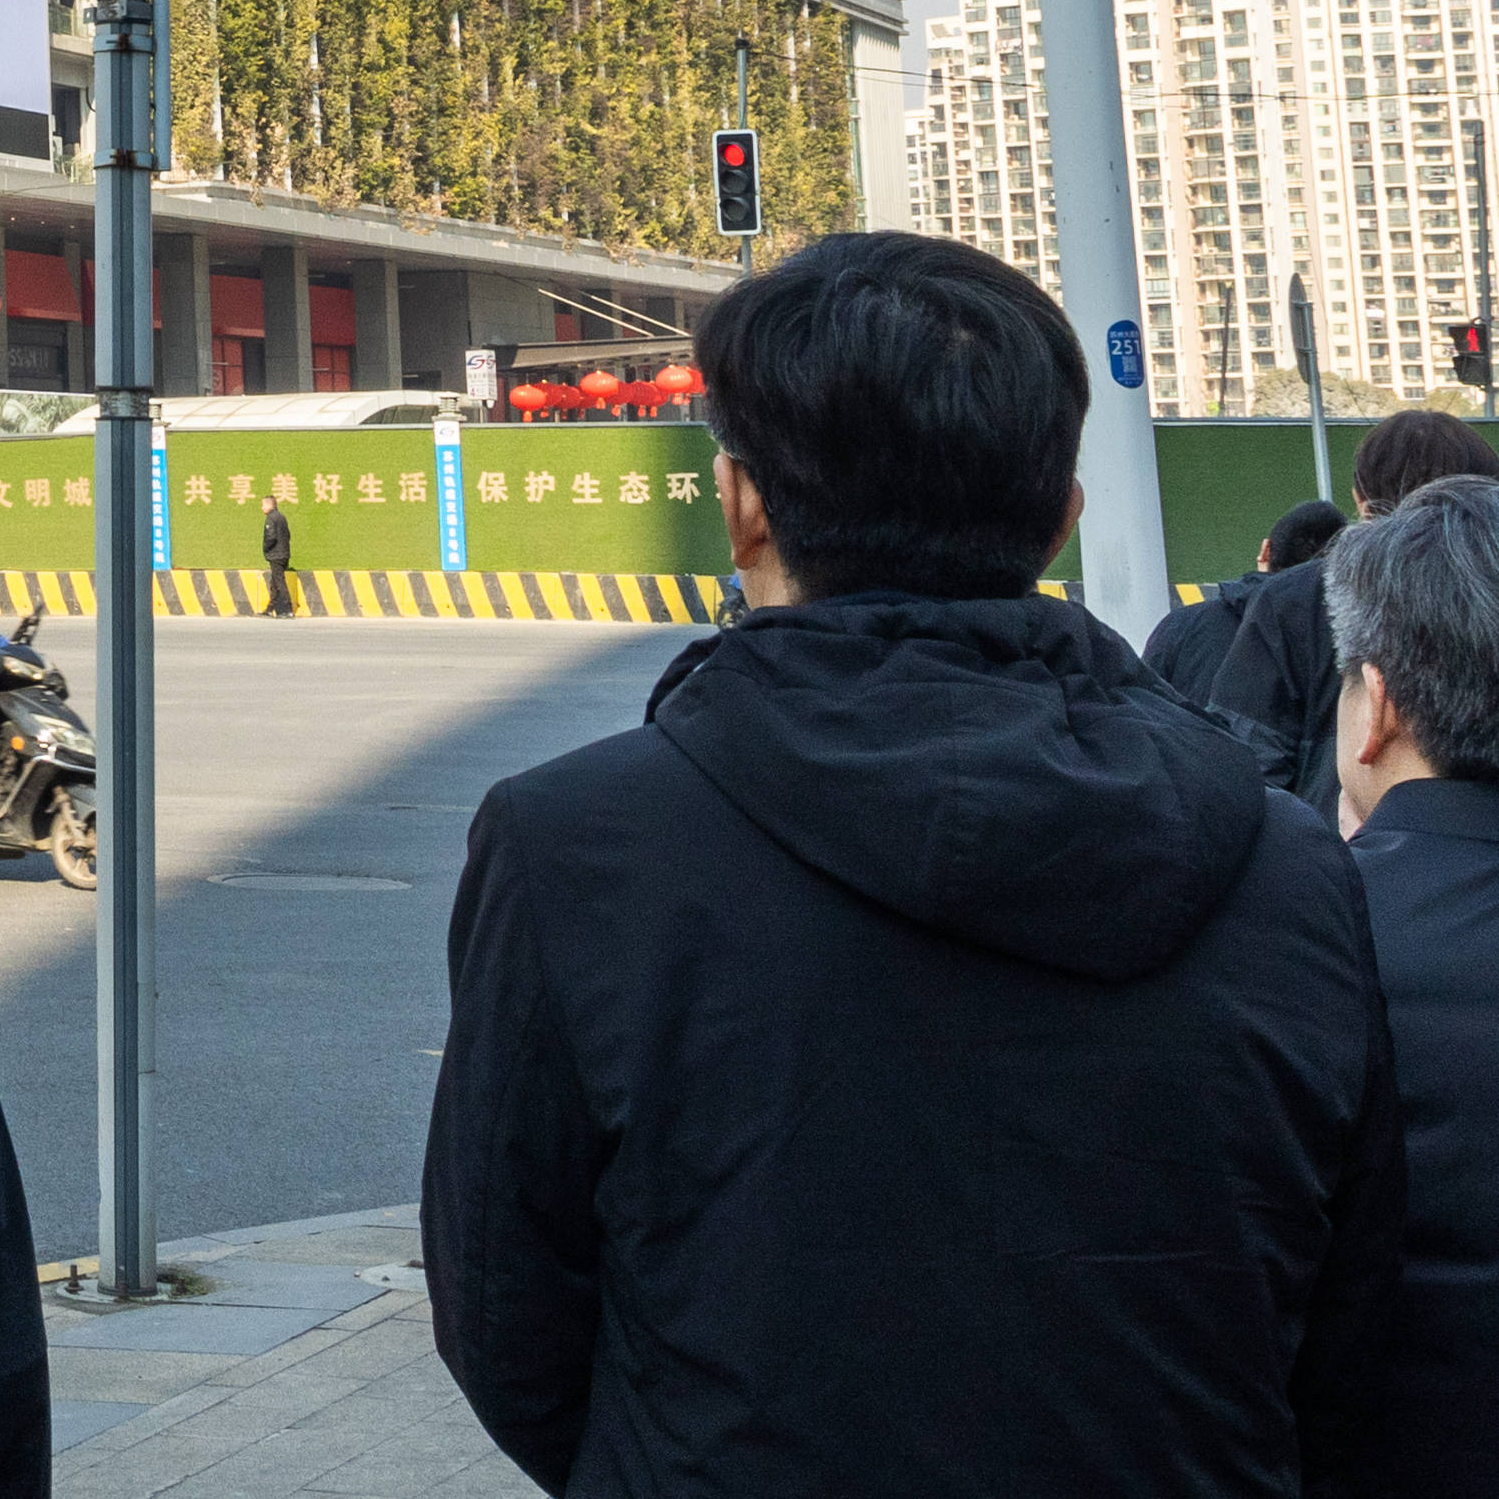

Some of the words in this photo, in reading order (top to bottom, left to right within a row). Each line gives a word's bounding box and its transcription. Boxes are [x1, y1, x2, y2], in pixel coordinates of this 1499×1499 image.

[1111, 340, 1140, 355] 251
[184, 472, 427, 505] 共享美好生活
[477, 471, 721, 504] 保护生态环
